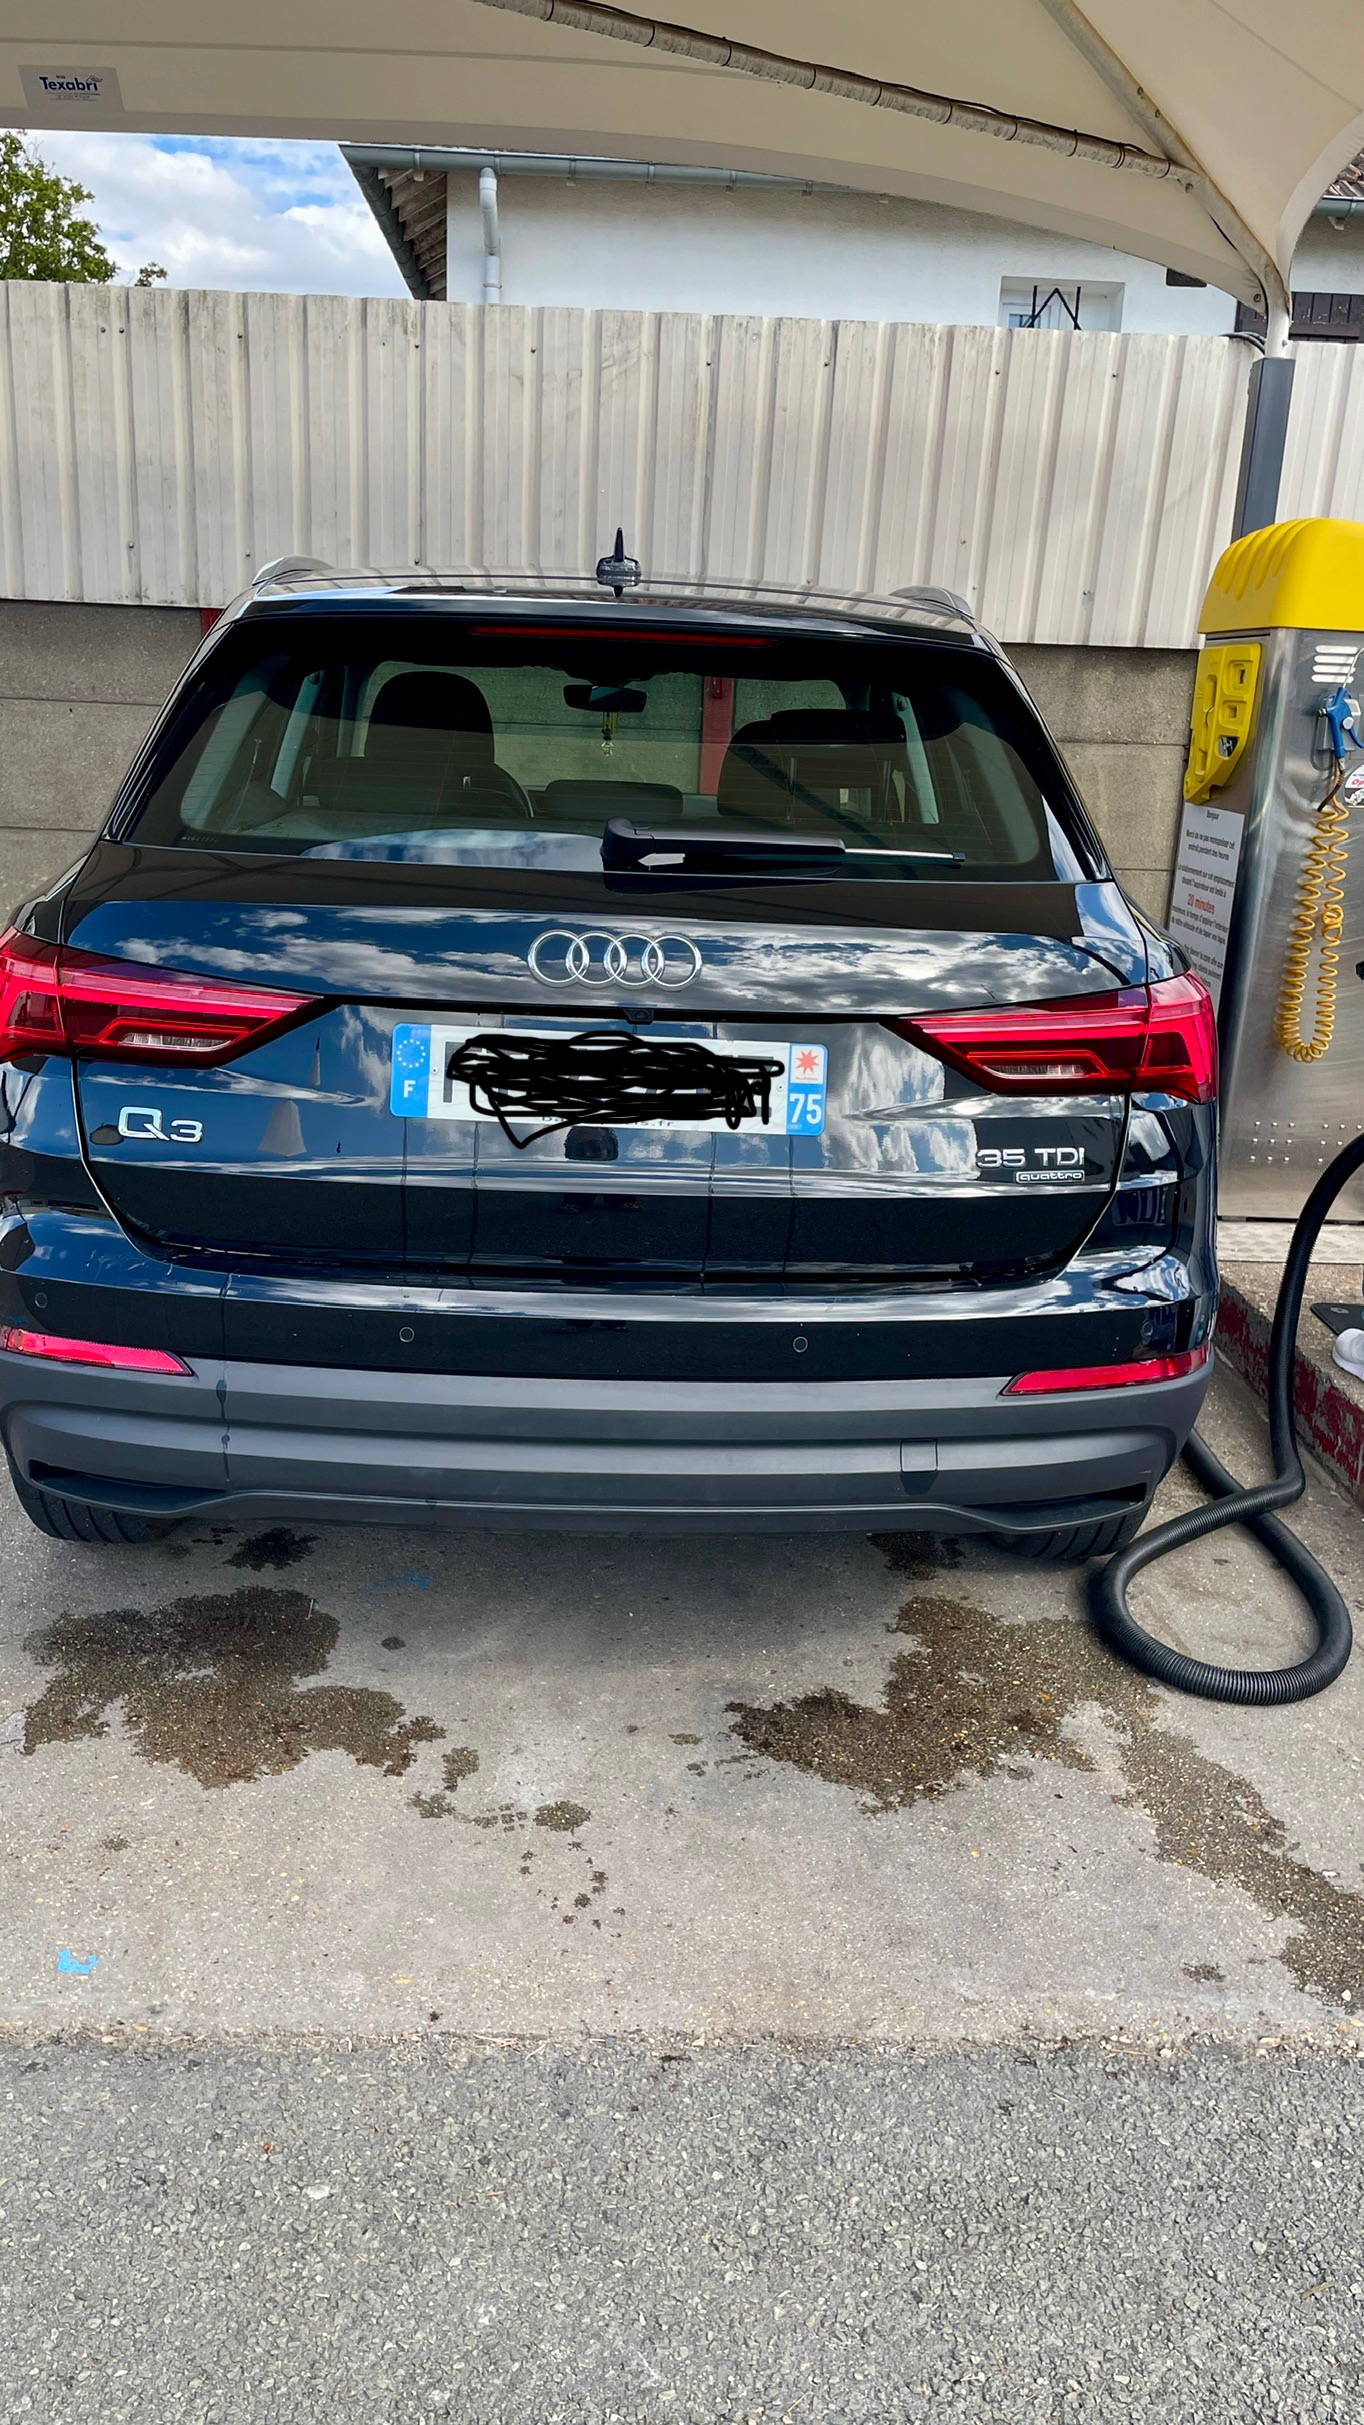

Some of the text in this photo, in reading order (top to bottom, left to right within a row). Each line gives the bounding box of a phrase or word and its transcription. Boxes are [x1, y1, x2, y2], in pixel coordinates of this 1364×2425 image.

[39, 76, 98, 91] Texabri
[1206, 809, 1219, 821] Bonjour
[1187, 893, 1215, 914] 20 minutes
[403, 1079, 416, 1098] F
[789, 1093, 822, 1125] 75
[118, 1106, 203, 1142] Q3
[976, 1147, 1085, 1168] 35 TDI
[1018, 1171, 1083, 1182] quattro
